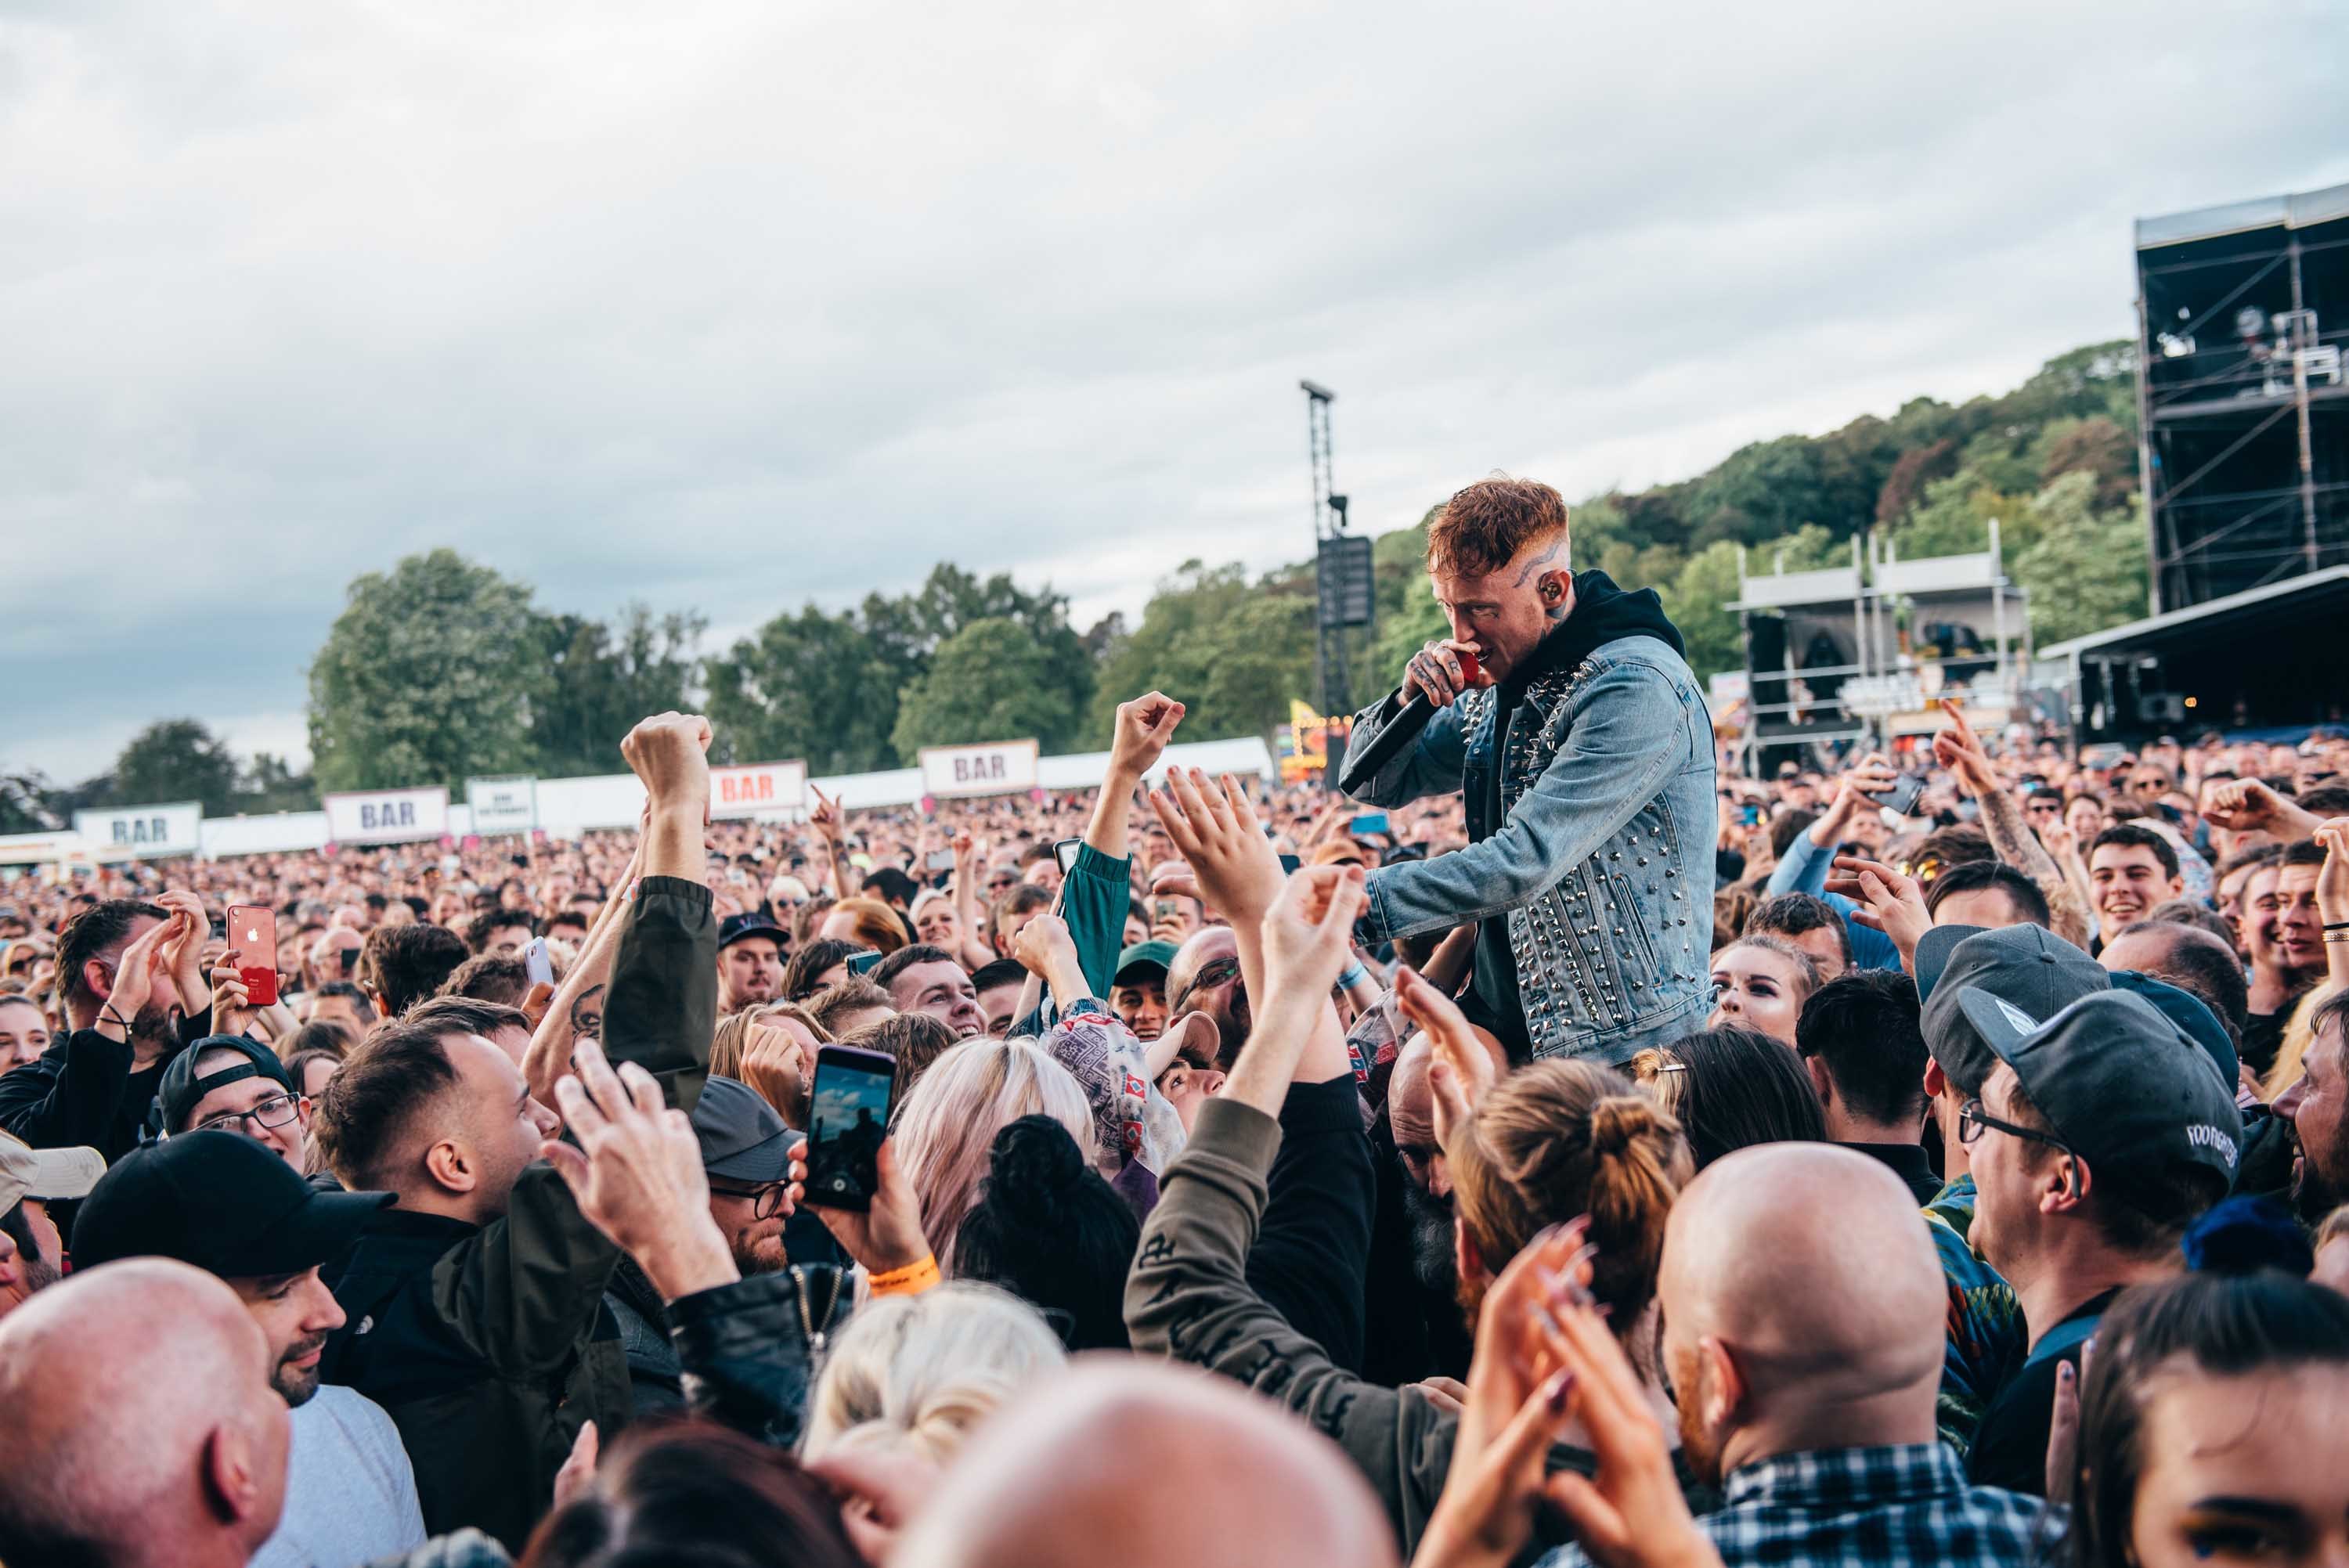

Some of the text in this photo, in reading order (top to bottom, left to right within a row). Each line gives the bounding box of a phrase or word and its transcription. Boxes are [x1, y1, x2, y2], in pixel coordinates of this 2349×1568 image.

[954, 755, 1006, 781] BAR
[721, 774, 774, 802] BAR
[361, 802, 416, 829] BAR
[112, 818, 168, 846] BAR
[2186, 1124, 2210, 1146] FOO
